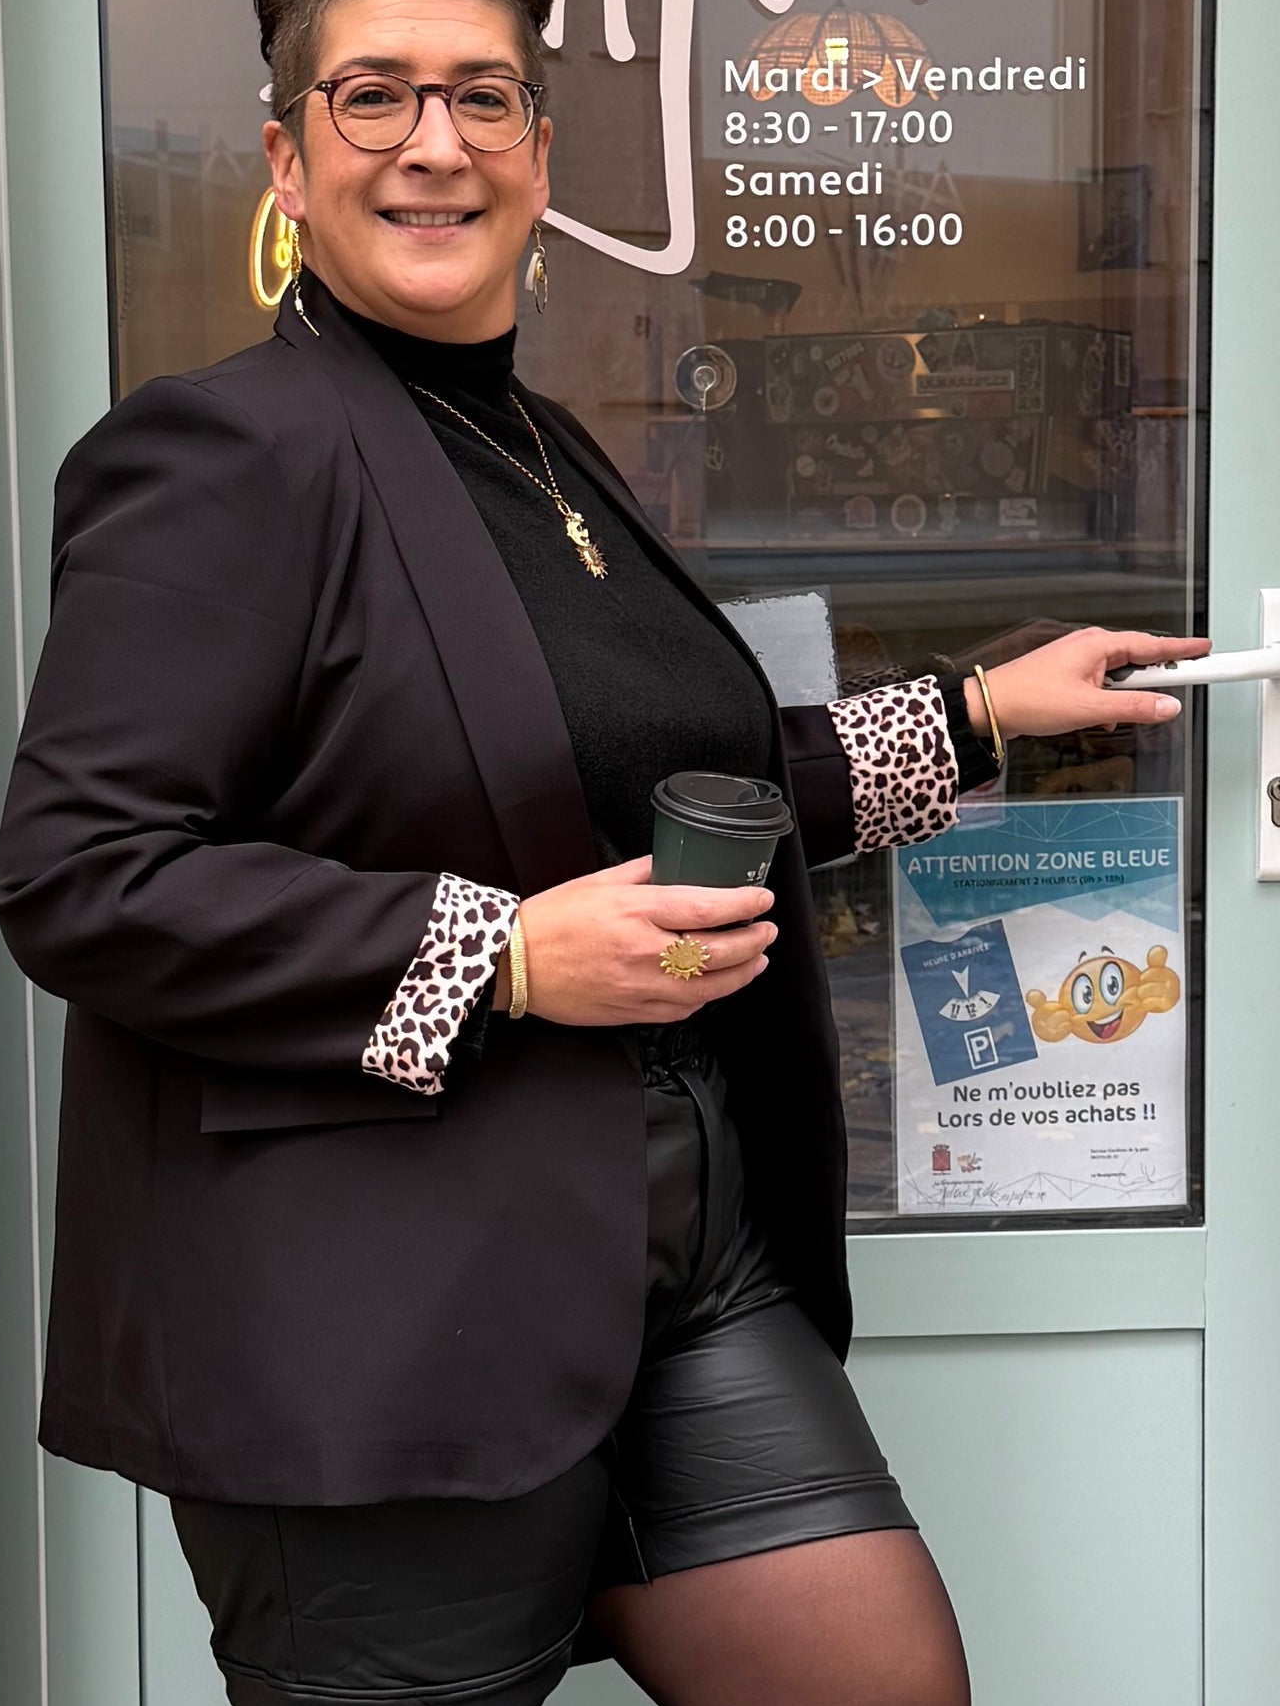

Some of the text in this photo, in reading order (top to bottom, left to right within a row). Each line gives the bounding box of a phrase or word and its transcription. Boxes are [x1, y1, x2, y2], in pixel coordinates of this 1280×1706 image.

[724, 59, 849, 92] Mardi
[894, 56, 1088, 91] Vendredi
[724, 109, 954, 145] 8:30 - 17:00
[724, 161, 883, 196] Samedi
[725, 214, 816, 248] 8:00
[855, 212, 963, 247] 16:00
[907, 848, 1171, 875] ATTENTION ZONE BLEUE
[965, 1003, 977, 1014] 12
[970, 1035, 990, 1062] P
[953, 1081, 1141, 1103] Ne m'oubliez pas
[937, 1103, 1157, 1128] Lors de vos achats !!
